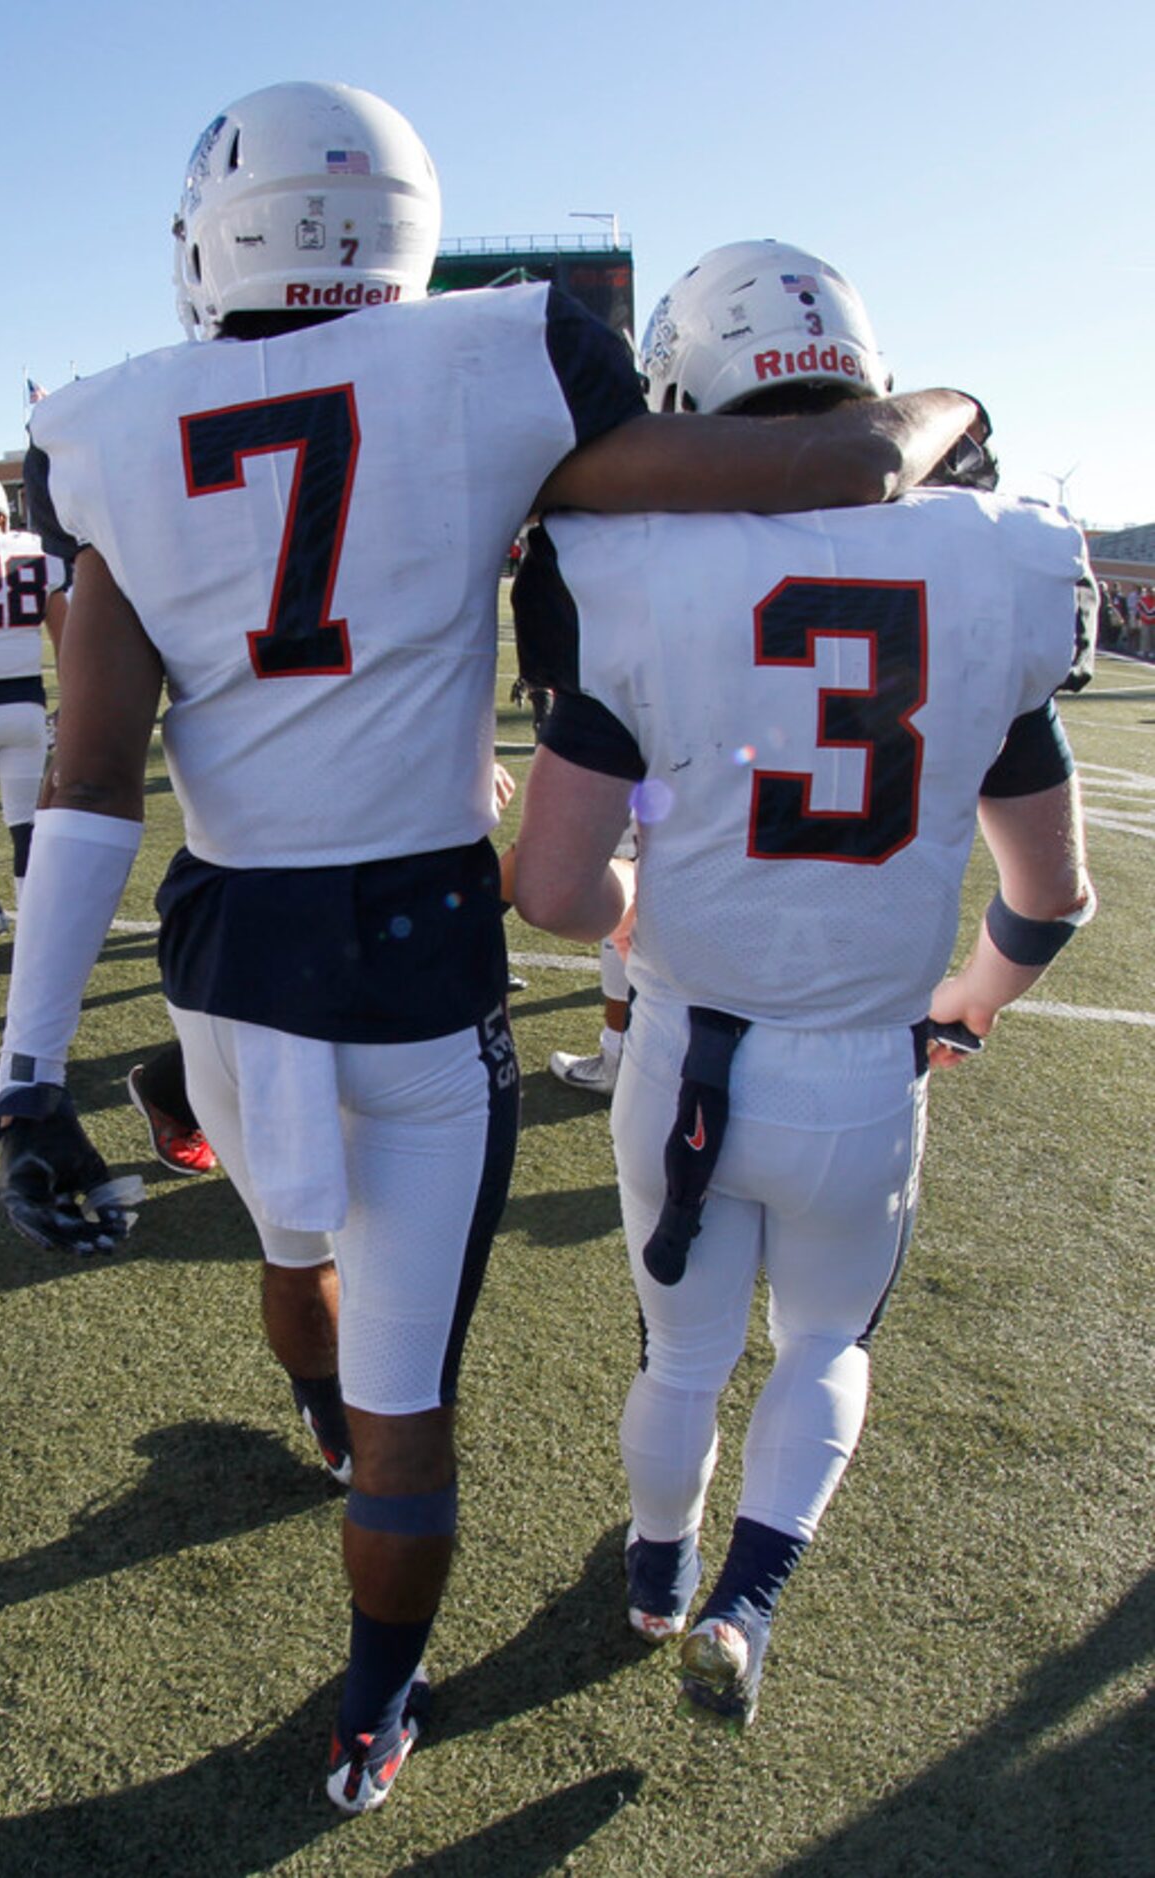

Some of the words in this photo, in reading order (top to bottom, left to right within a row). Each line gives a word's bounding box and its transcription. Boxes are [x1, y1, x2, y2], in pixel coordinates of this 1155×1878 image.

[340, 237, 359, 267] 7
[285, 282, 402, 306] Riddell
[805, 311, 824, 337] 3
[178, 381, 361, 679] 7
[747, 575, 929, 867] 3
